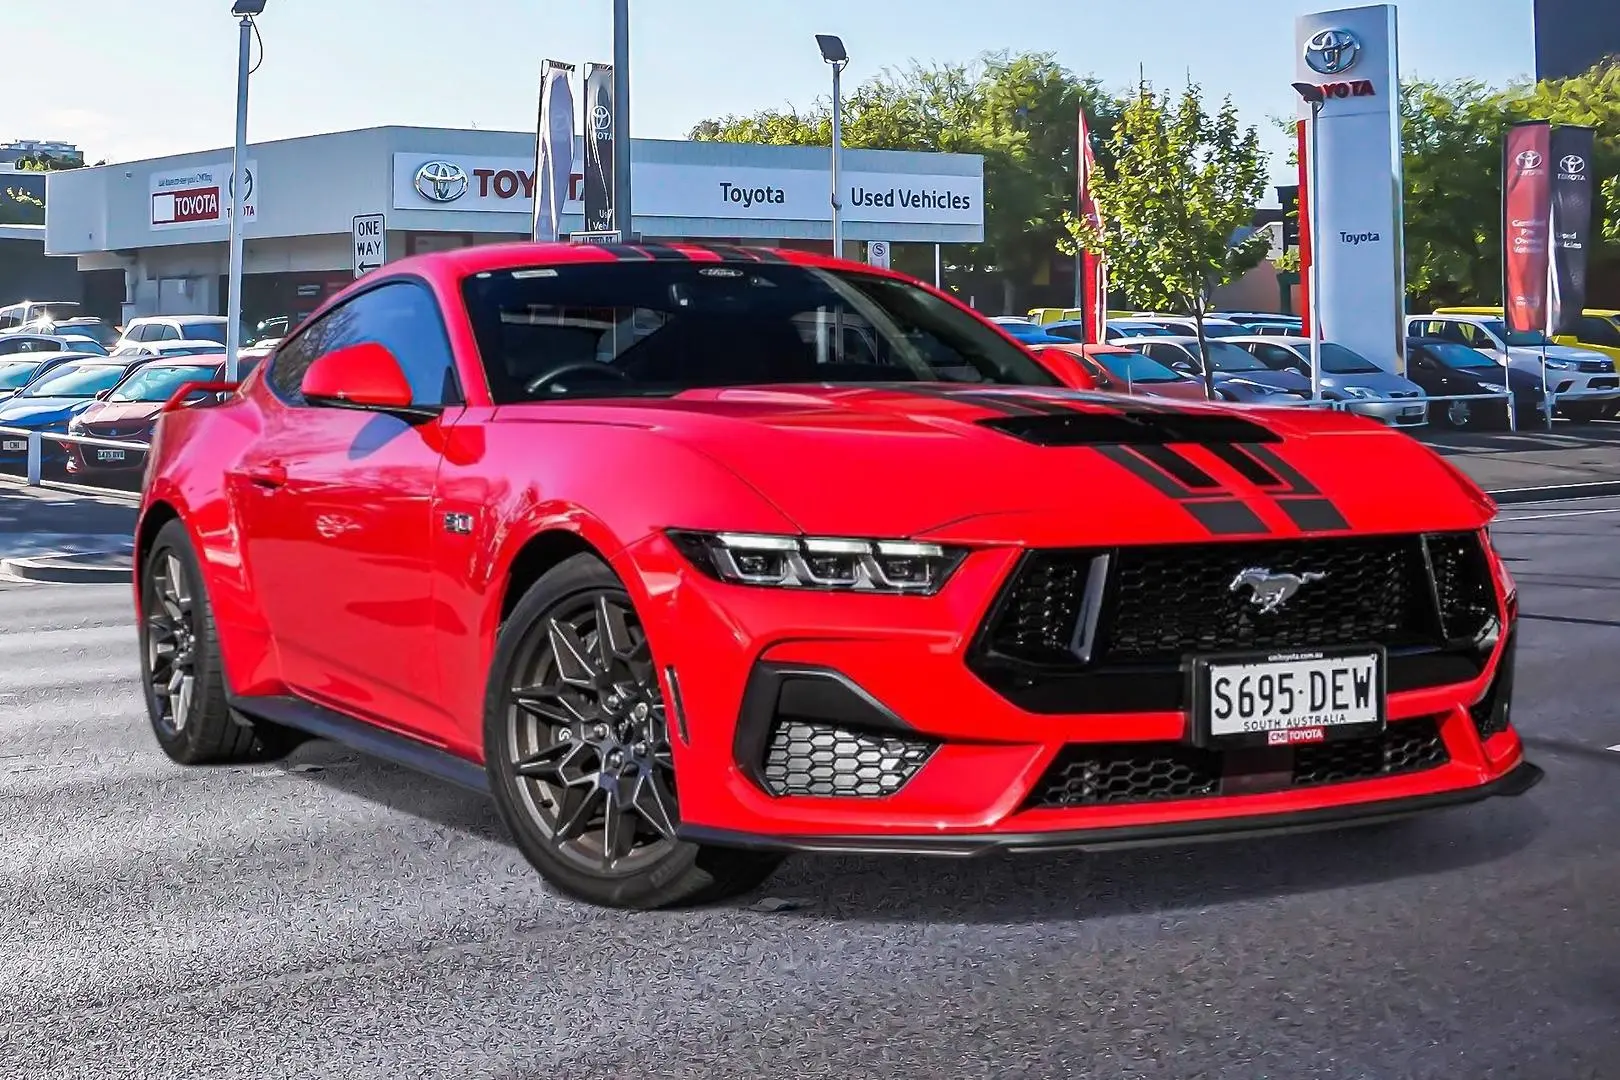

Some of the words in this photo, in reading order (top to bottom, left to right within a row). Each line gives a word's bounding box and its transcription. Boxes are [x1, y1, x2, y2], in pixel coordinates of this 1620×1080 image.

[473, 168, 585, 201] TOYT
[719, 182, 785, 208] Toyota
[851, 187, 895, 208] Used
[898, 188, 970, 210] Vehicles
[175, 193, 218, 217] TOYOTA
[358, 220, 380, 237] ONE
[1339, 231, 1380, 245] Toyota
[356, 240, 381, 256] WAY
[1243, 720, 1282, 732] SOUTH
[1286, 713, 1347, 728] AUSTRALIA
[1289, 728, 1324, 742] TOYOTA
